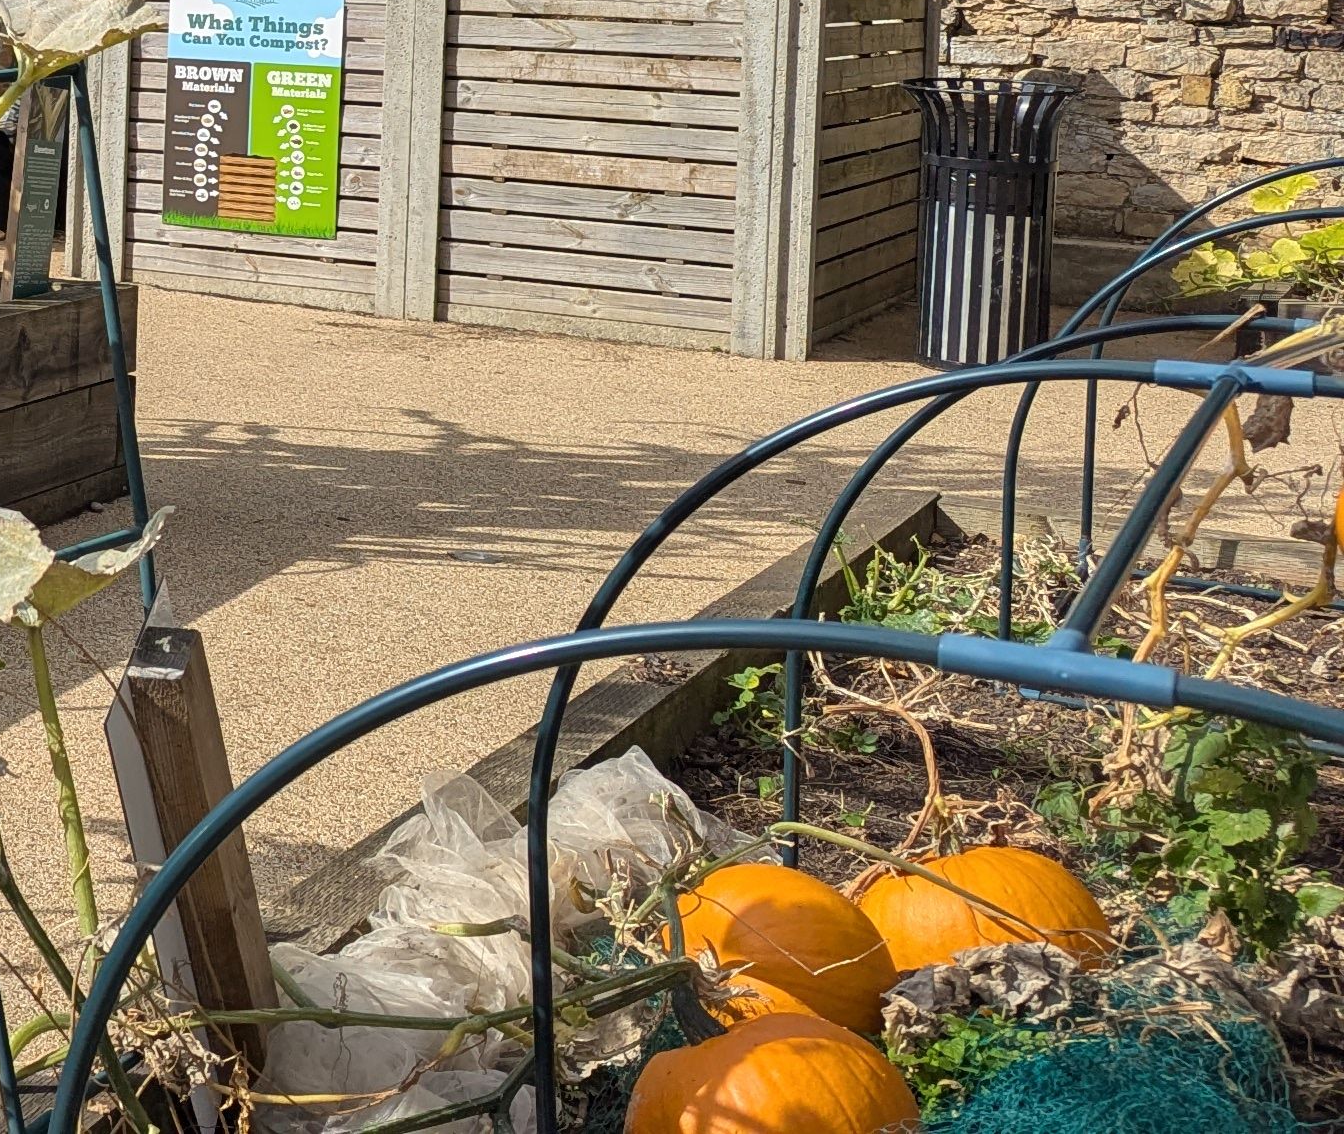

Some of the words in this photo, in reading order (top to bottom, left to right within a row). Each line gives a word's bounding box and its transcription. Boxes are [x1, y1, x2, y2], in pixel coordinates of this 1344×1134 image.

[187, 13, 243, 32] What
[248, 16, 324, 38] Things
[181, 32, 212, 45] Can
[215, 33, 245, 47] You
[249, 35, 328, 52] Compost?
[174, 65, 244, 83] BROWN
[266, 70, 333, 88] GREEN
[181, 81, 235, 94] Materials
[271, 86, 327, 100] Materials
